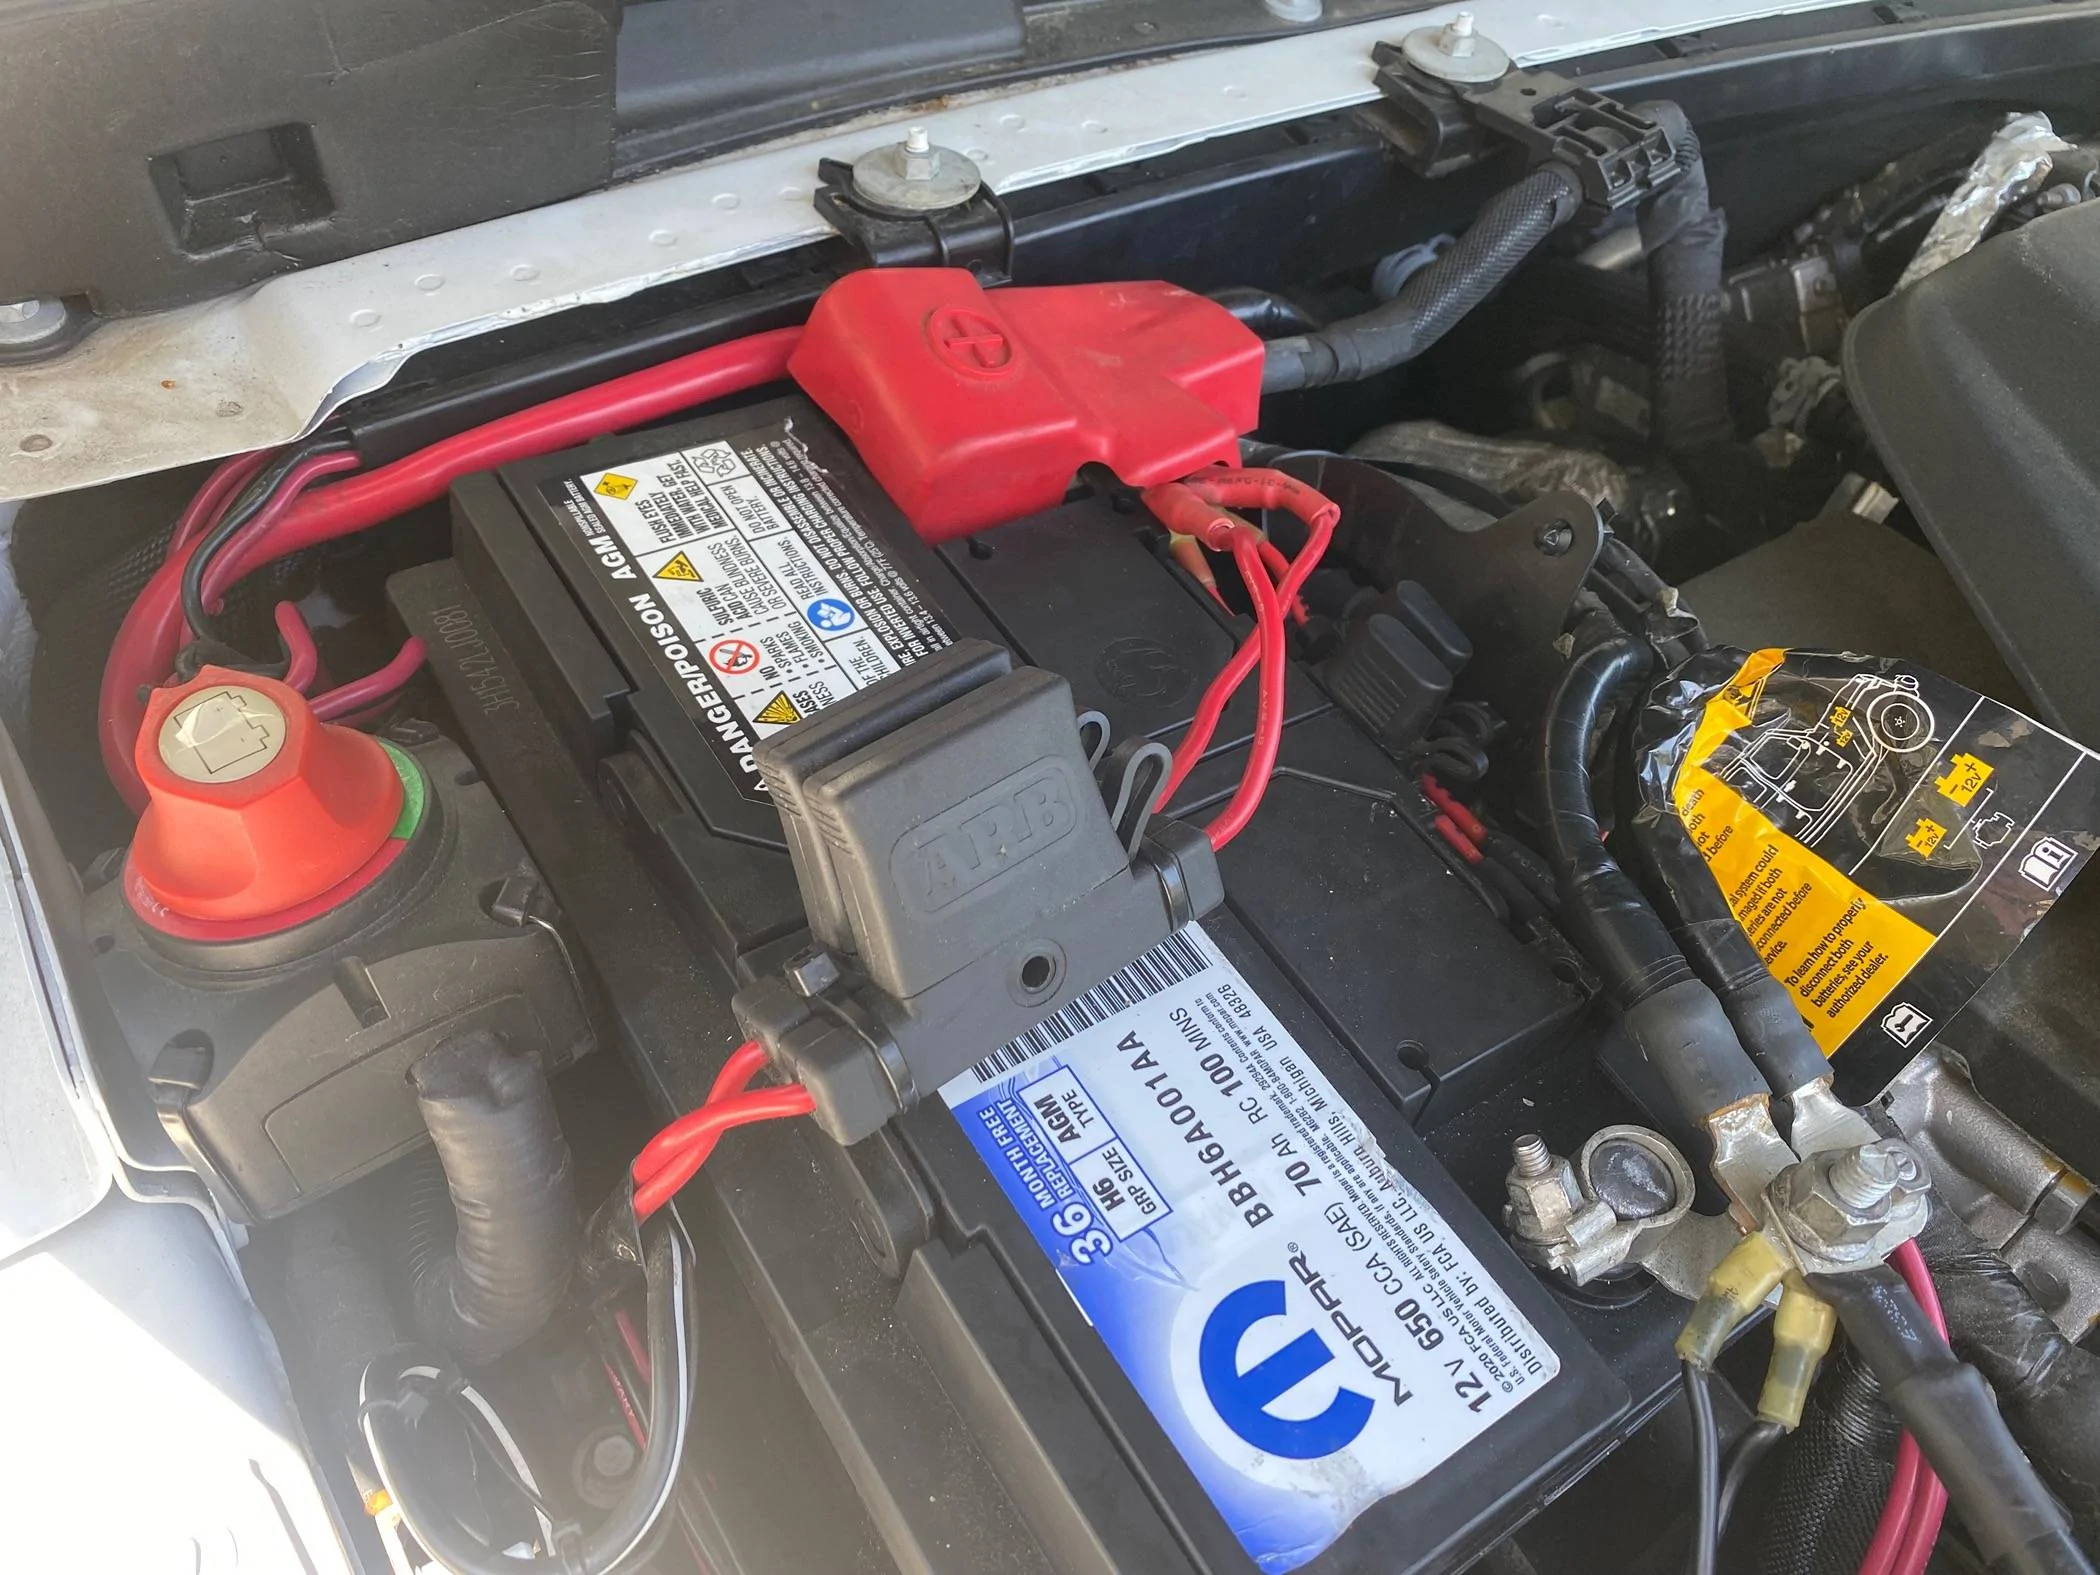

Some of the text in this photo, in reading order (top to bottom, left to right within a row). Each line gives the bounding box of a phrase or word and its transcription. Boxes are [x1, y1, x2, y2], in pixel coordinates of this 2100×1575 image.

[562, 478, 606, 534] SEALED AGM BATTERY.
[655, 473, 711, 534] WITH WATER. GET
[666, 458, 728, 529] MEDICAL HELP FAST.
[719, 484, 766, 534] DO NOT OPEN
[745, 495, 780, 530] BATTERY.
[562, 498, 595, 536] NONSPILLABLE
[633, 498, 676, 544] FLUSH EYES
[647, 490, 694, 539] IMMEDIATELY
[587, 534, 637, 579] AGM
[739, 446, 904, 650] EXPLOSION OR BURNS. DO NOT DISASSEMBLE OR INCINERATE.
[754, 443, 929, 657] FOR INVERTED USE. FOLLOW PROPER CHARGING INSTRUCTIONS.
[776, 536, 828, 596] INSTRUCTIONS.
[706, 541, 770, 615] CAUSE BLINDNESS
[723, 534, 787, 610] OR SEVERE BURNS.
[777, 561, 814, 600] READ ALL
[695, 587, 734, 626] SULFURIC
[714, 582, 753, 620] ACID CAN
[759, 635, 792, 669] SPARKS
[774, 630, 808, 664] FLAMES
[786, 620, 824, 658] SMOKING
[627, 592, 768, 773] DANGER/POISON
[758, 665, 780, 681] NO
[847, 655, 870, 675] THE
[791, 689, 821, 718] ASES
[1682, 788, 1705, 817] death
[1706, 824, 1734, 857] before
[1735, 844, 1779, 898] system could
[1761, 867, 1783, 891] both
[1761, 887, 1788, 918] are not
[1786, 881, 1812, 912] before
[1783, 896, 1866, 987] To learn how to properly
[1798, 938, 1854, 998] disconnect both
[1809, 940, 1874, 1008] batteries, see your
[1825, 974, 1866, 1018] authorized
[1859, 952, 1889, 985] dealer.
[1194, 997, 1204, 1007] to
[1199, 1004, 1225, 1033] conform
[1204, 991, 1252, 1047] www.mopar.com
[1221, 1031, 1249, 1063] Contents
[1245, 1062, 1271, 1091] 29294A
[1032, 1093, 1081, 1143] AGM
[1060, 1088, 1094, 1129] TYPE
[1268, 1089, 1302, 1129] trademark.
[996, 1093, 1078, 1199] REPLACEMENT
[1115, 1029, 1274, 1228] BBH6A001AA
[1295, 1126, 1331, 1164] registered
[978, 1101, 1059, 1208] MONTH FREE
[1320, 1132, 1355, 1174] applicable.
[1091, 1176, 1125, 1211] H6
[1101, 1146, 1157, 1215] GRP SIZE
[1216, 983, 1543, 1375] Distributed by: FCA US LLC, Auburn Hills, Michigan USA 48326
[1337, 1177, 1361, 1203] Mopar
[1352, 1173, 1366, 1188] are
[1362, 1188, 1379, 1204] any
[1168, 1006, 1492, 1413] 12 V 650 CCA (SAE) 70 Ah RC 100 MINS
[1356, 1200, 1391, 1241] RESERVED.
[1052, 1195, 1119, 1263] 36
[1383, 1209, 1419, 1254] Standards,
[1385, 1238, 1413, 1268] RIGHTS
[1415, 1252, 1440, 1280] Safety
[1408, 1264, 1424, 1281] ALL
[1421, 1282, 1445, 1308] LLC
[1437, 1278, 1464, 1311] Vehicle
[1441, 1307, 1460, 1327] US
[1461, 1309, 1486, 1336] Motor
[1457, 1324, 1481, 1353] FCA
[1480, 1333, 1511, 1368] Federal
[1477, 1352, 1505, 1381] 2020
[1508, 1365, 1525, 1386] U.S.
